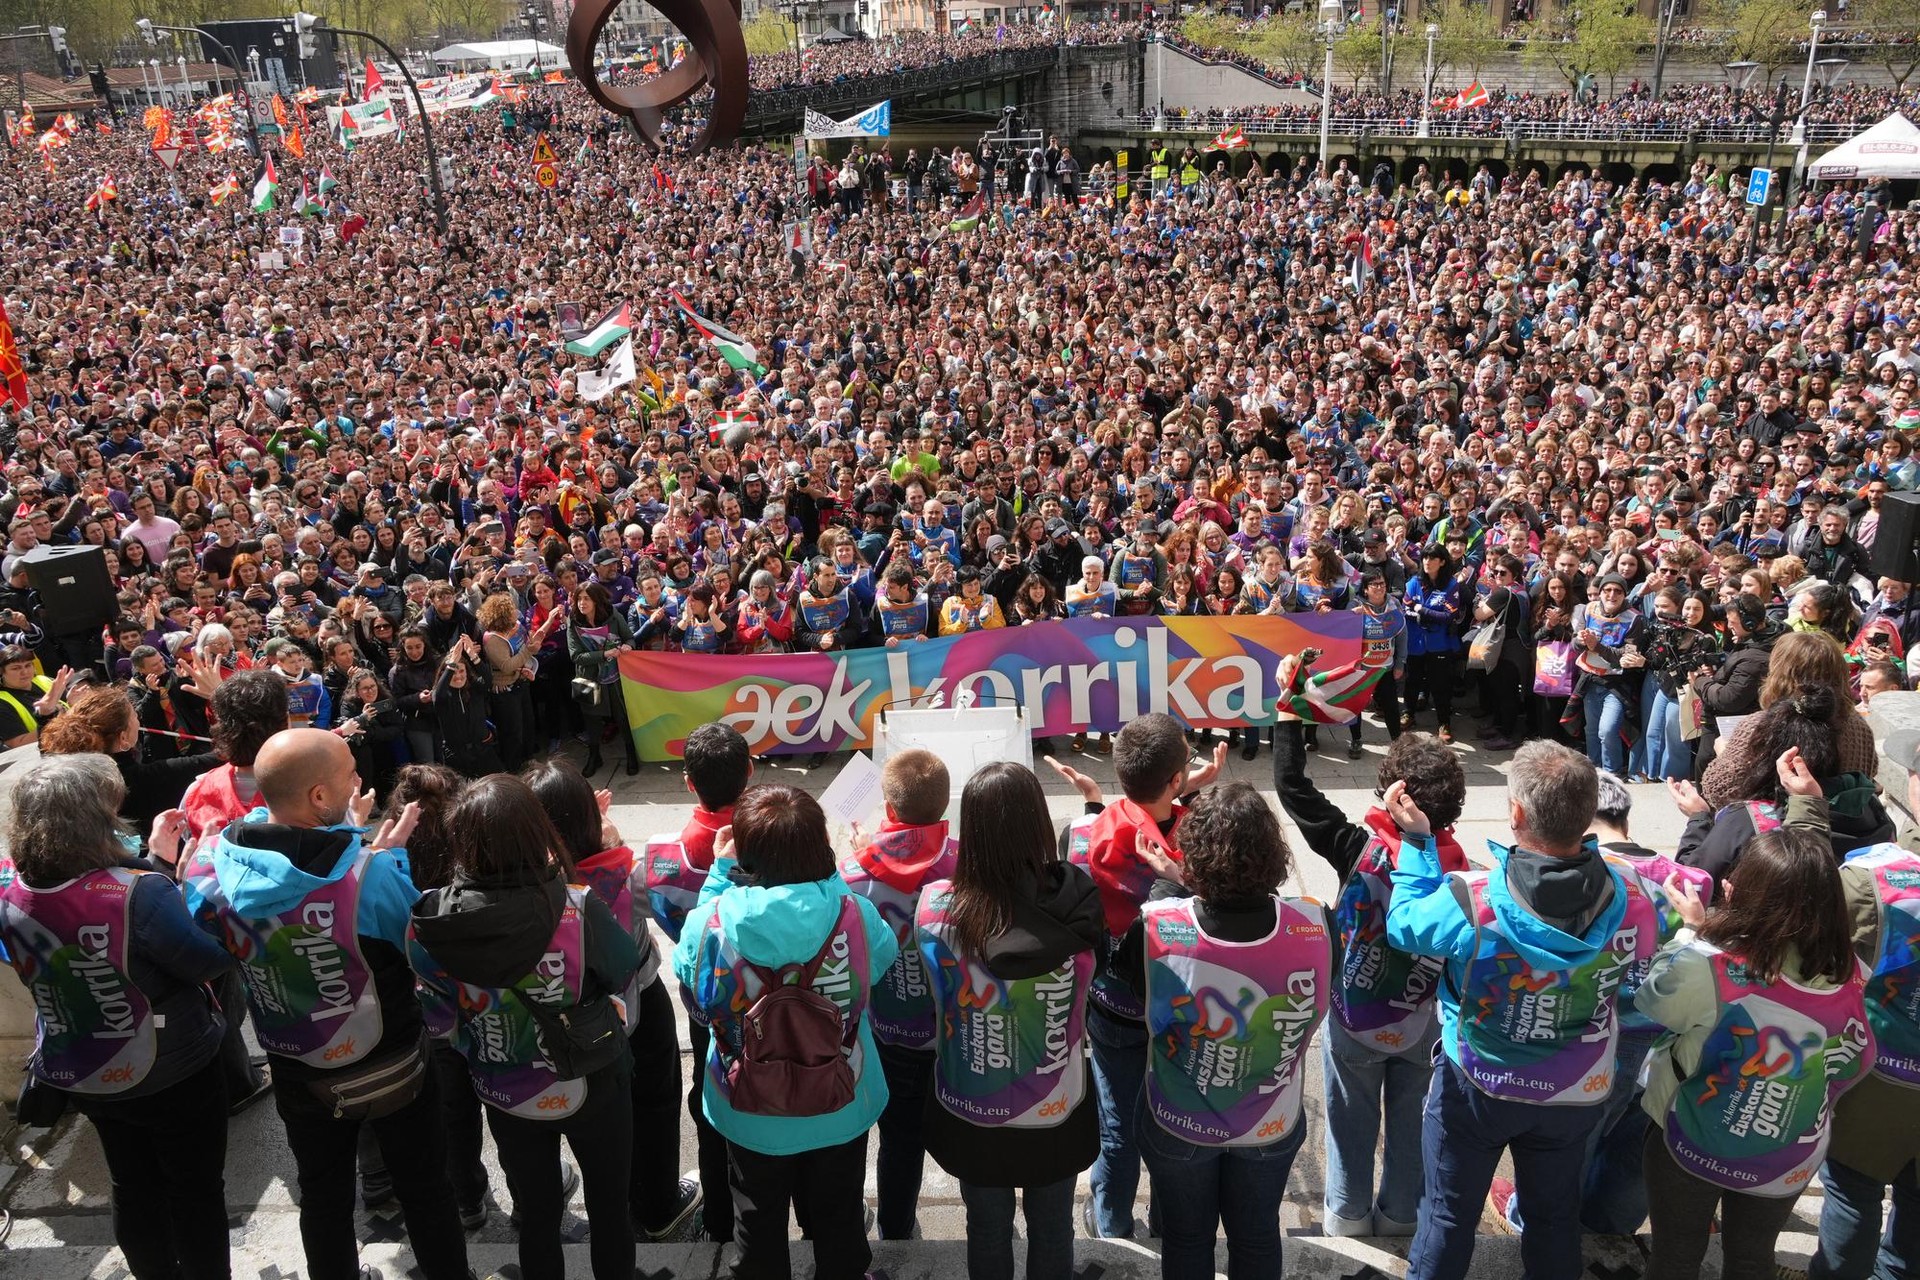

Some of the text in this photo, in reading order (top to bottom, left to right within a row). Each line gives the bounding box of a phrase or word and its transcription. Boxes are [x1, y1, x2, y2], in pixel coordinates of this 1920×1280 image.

[541, 171, 553, 181] 30
[718, 655, 872, 745] aek
[95, 884, 128, 892] EROSKI
[1296, 925, 1323, 934] EROSKI
[291, 900, 355, 1022] korrika
[904, 949, 927, 997] gara
[1354, 945, 1382, 991] gara
[69, 922, 136, 1039] korrika
[484, 1013, 510, 1062] gara
[874, 1018, 930, 1038] korrika.eus
[970, 1012, 985, 1075] Euskara
[987, 1014, 1011, 1069] gara
[1258, 968, 1316, 1096] korrika
[1375, 1030, 1405, 1047] aek
[323, 1036, 356, 1061] aek
[1211, 1044, 1238, 1088] gara
[101, 1062, 136, 1084] aek
[1473, 1066, 1556, 1092] korrika.eus
[1583, 1070, 1610, 1093] aek
[536, 1093, 571, 1110] aek
[941, 1087, 1011, 1117] korrika.eus
[1038, 1093, 1069, 1117] aek
[1729, 1081, 1766, 1138] Euskara
[1752, 1081, 1791, 1139] gara
[1156, 1102, 1231, 1140] korrika.eus
[1256, 1112, 1287, 1138] aek
[1675, 1141, 1759, 1183] korrika.eus
